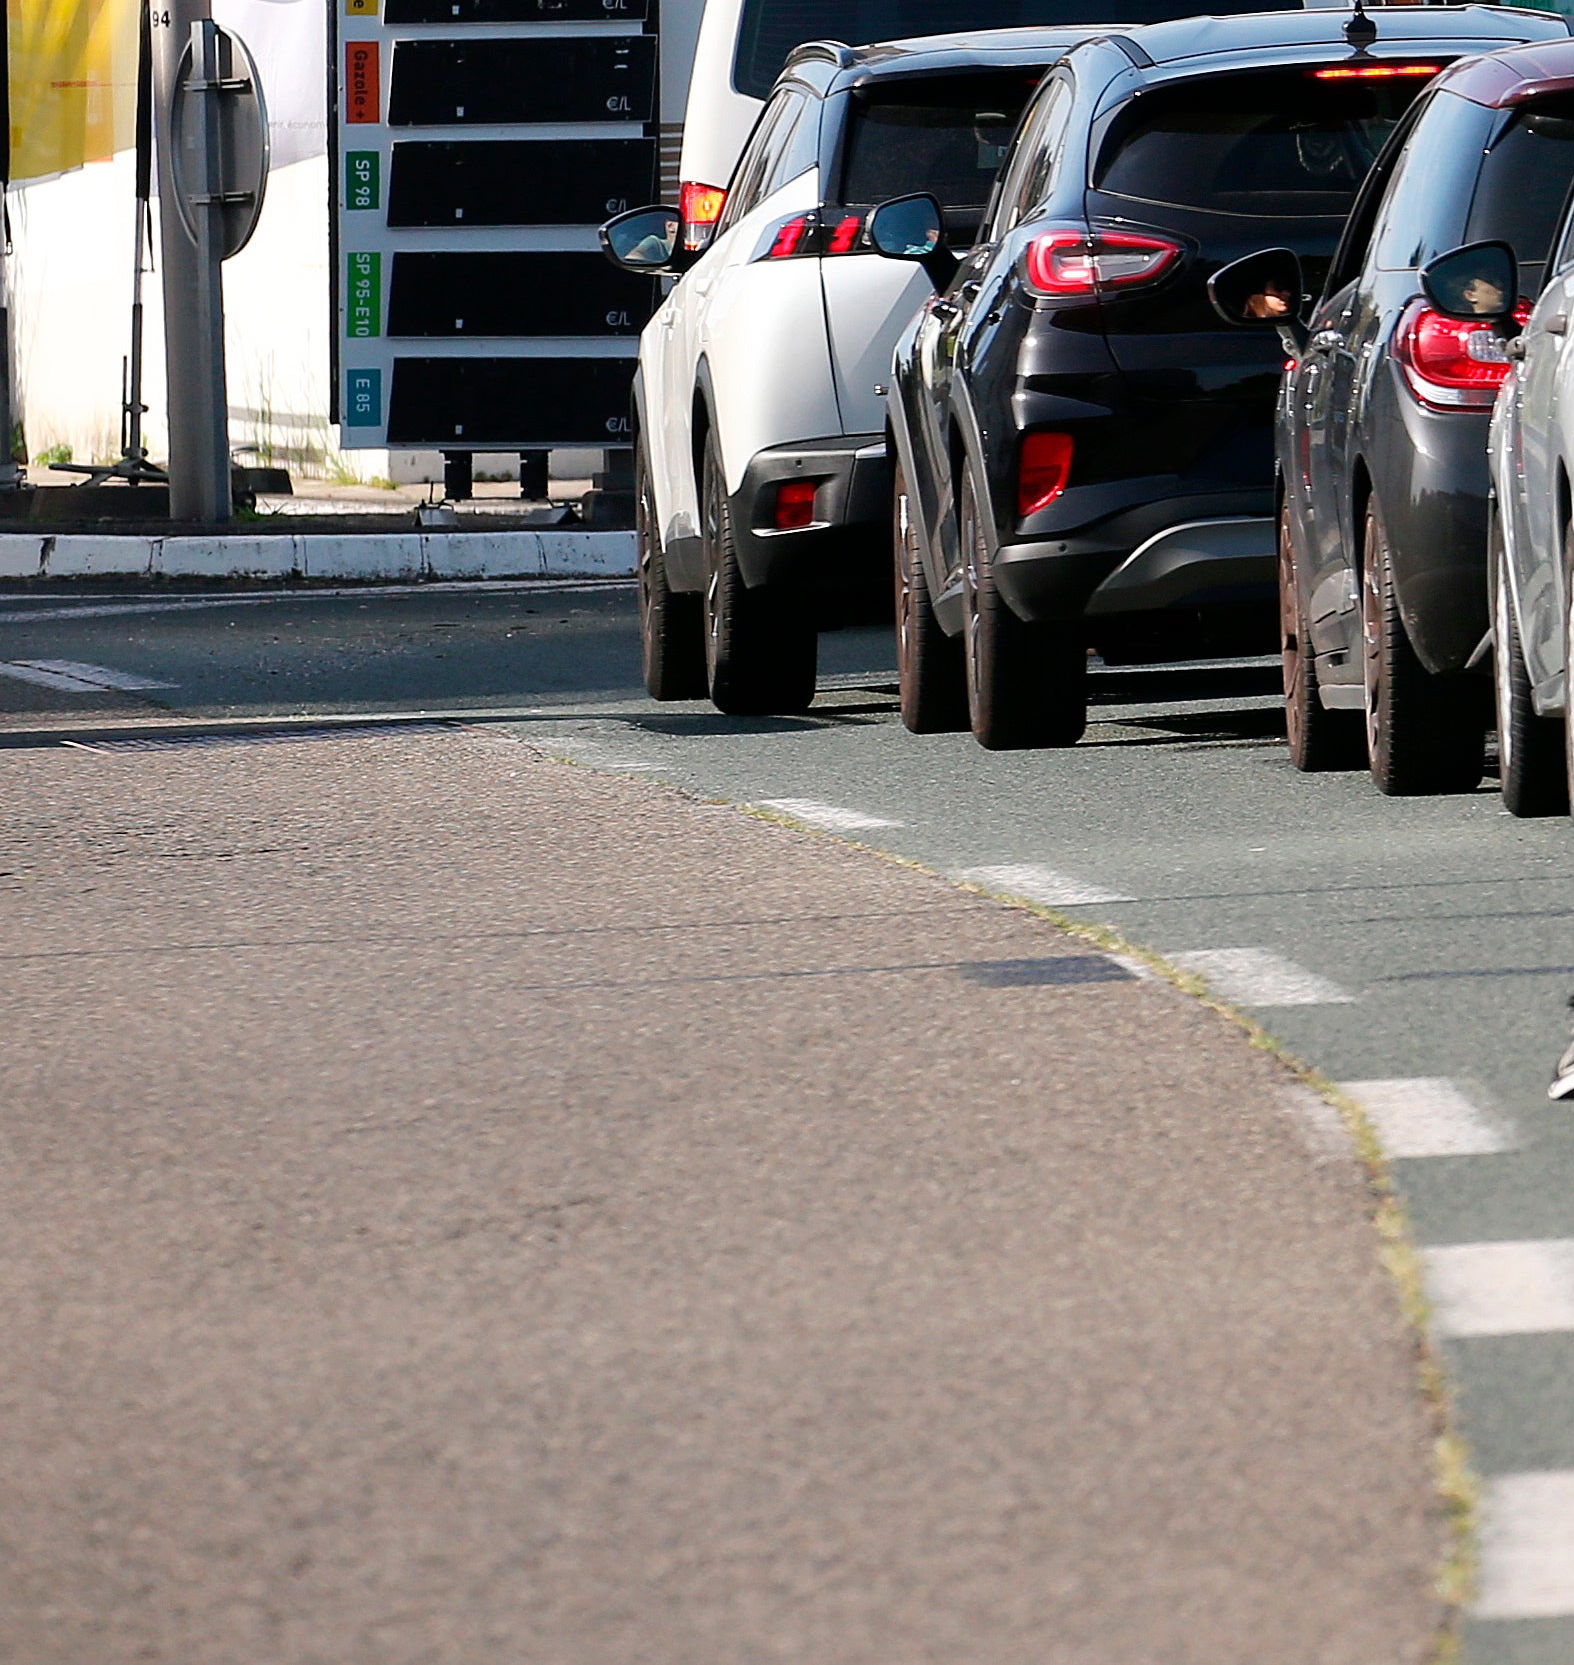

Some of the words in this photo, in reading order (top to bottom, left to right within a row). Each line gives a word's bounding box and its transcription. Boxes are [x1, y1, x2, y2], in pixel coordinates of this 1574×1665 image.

[152, 10, 171, 28] 94
[353, 49, 368, 106] Gazole
[606, 96, 631, 112] €/L
[355, 159, 370, 182] SP
[355, 187, 370, 207] 98
[355, 253, 370, 275] SP
[355, 278, 370, 336] 95-E10
[606, 311, 631, 326] €/L
[356, 378, 370, 388] E
[356, 393, 370, 413] 85
